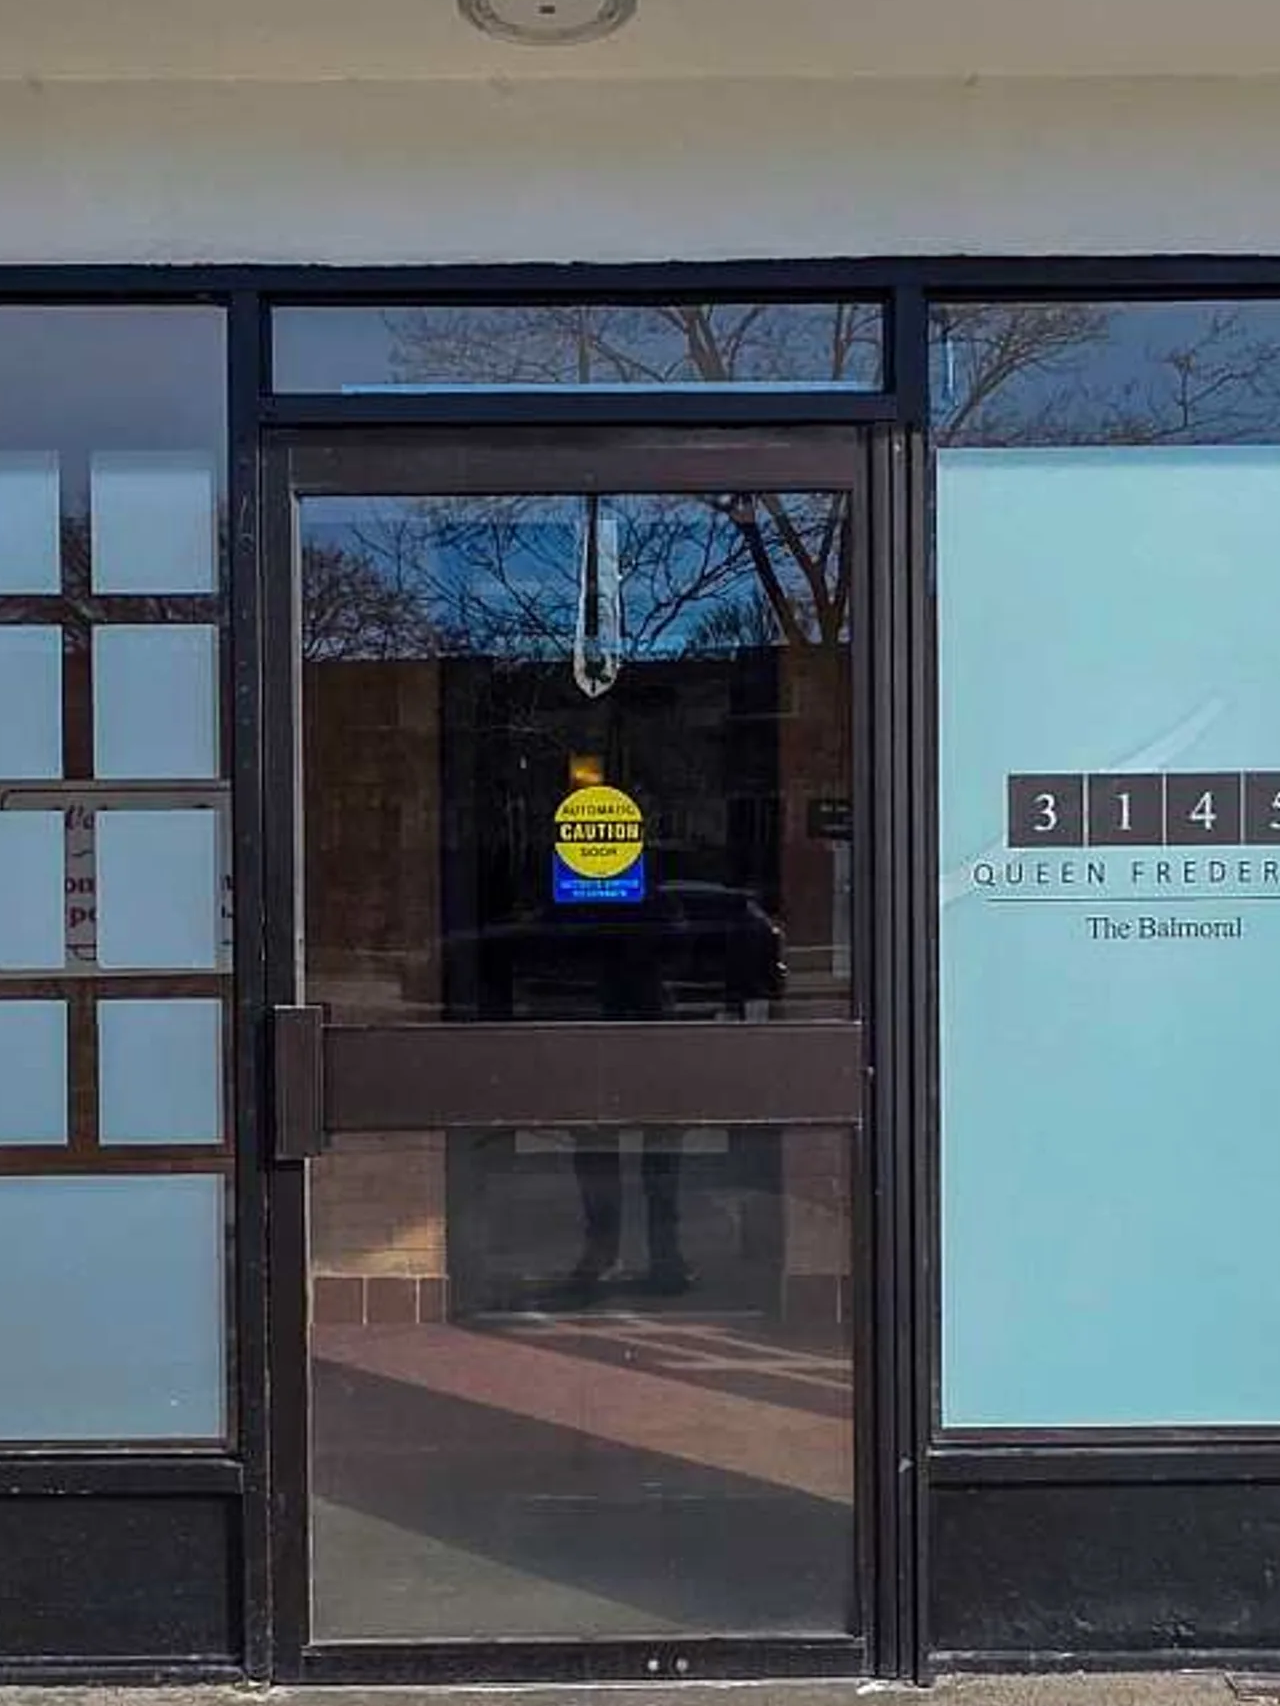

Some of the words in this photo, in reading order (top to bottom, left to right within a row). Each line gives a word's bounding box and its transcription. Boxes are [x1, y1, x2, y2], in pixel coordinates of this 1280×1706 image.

[560, 823, 639, 840] CAUTION
[973, 863, 1106, 886] QUEEN
[1086, 916, 1132, 939] The
[1138, 916, 1242, 939] Balmoral
